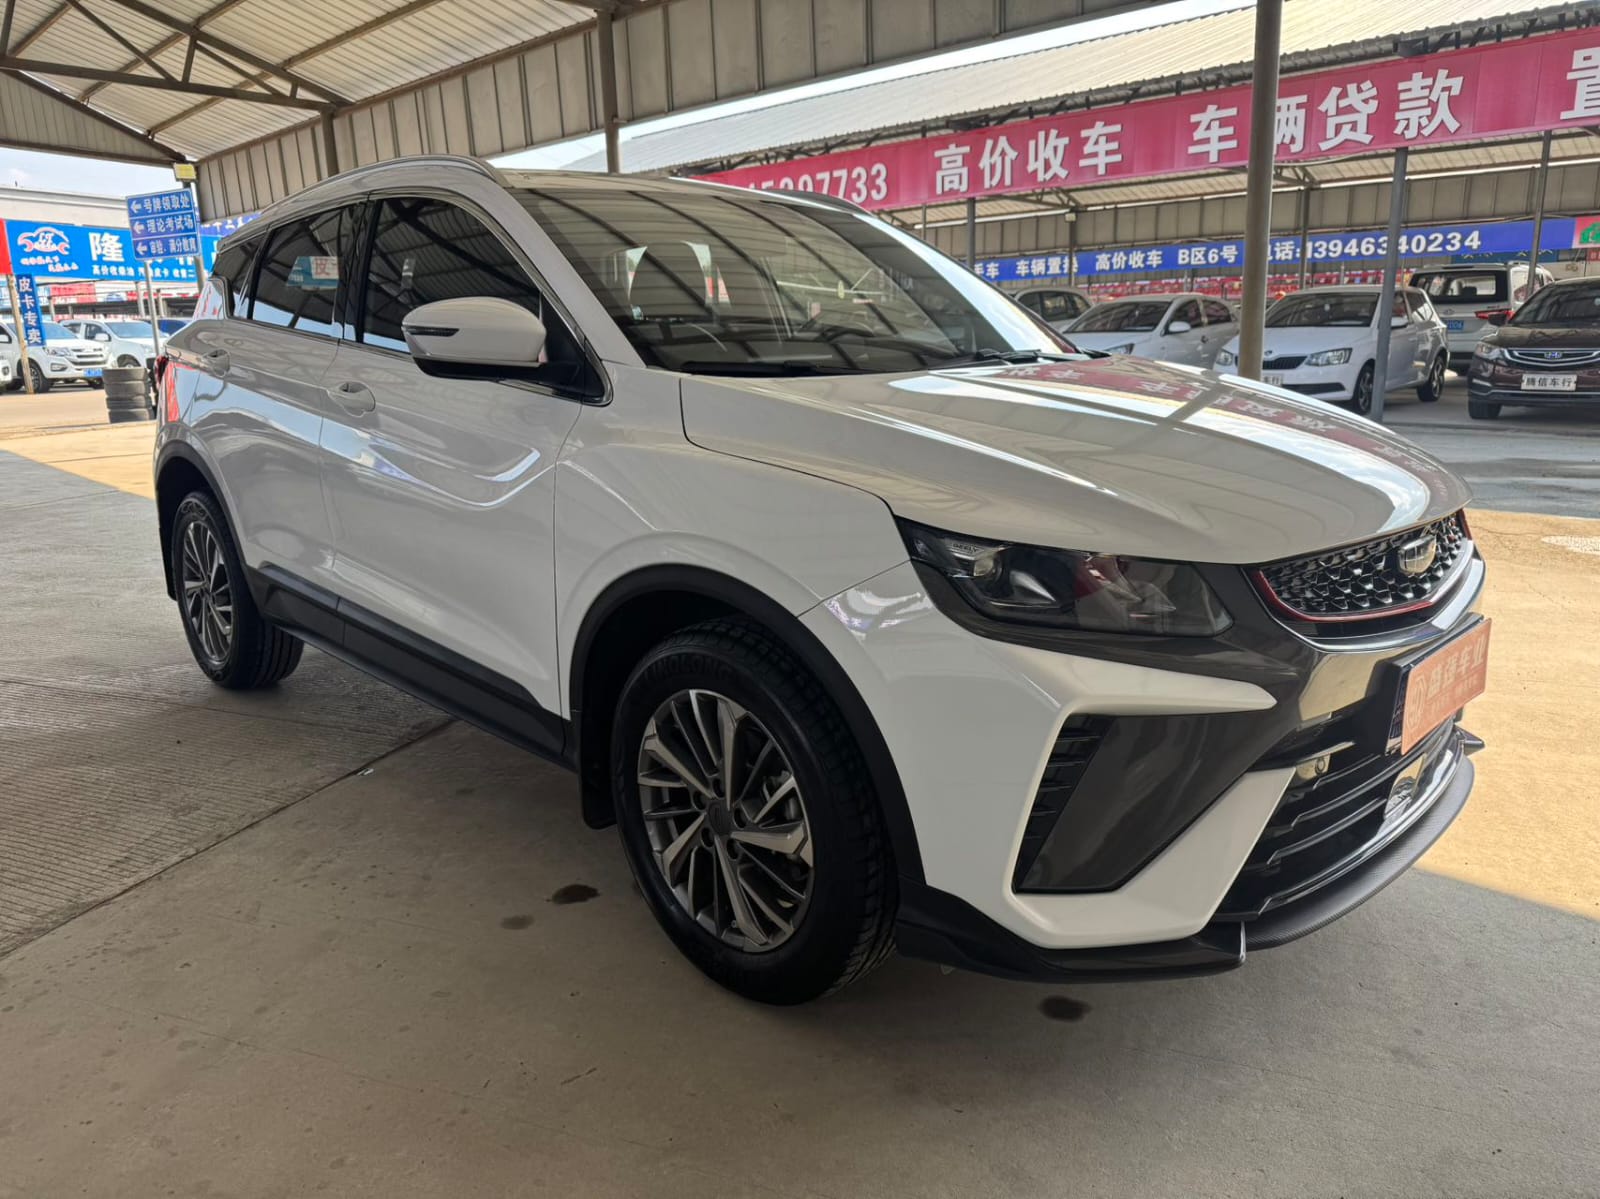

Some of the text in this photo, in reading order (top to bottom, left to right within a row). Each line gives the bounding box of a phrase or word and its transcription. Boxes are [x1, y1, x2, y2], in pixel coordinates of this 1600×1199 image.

[934, 120, 1122, 195] 高价收车
[146, 214, 194, 233] 理论考试场
[88, 232, 125, 262] 隆
[1095, 250, 1163, 271] 高价收车
[1177, 245, 1239, 265] B区6号
